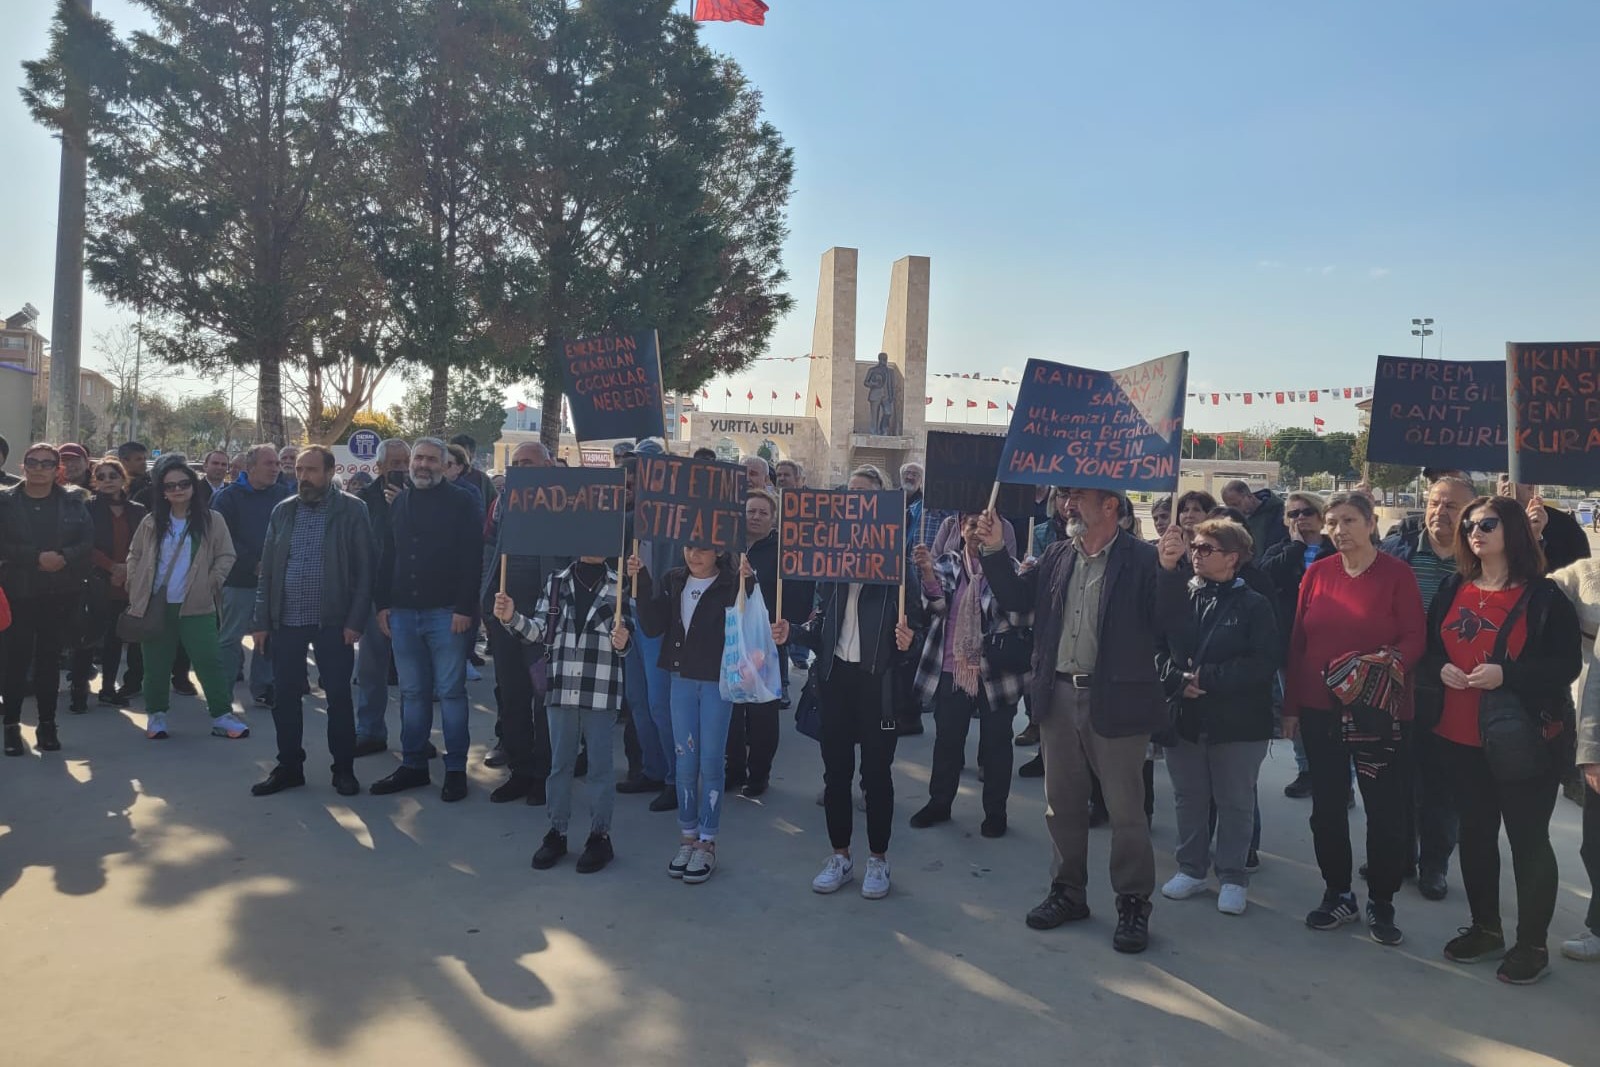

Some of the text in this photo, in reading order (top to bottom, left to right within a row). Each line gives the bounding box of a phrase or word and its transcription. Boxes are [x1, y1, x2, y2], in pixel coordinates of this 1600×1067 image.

[1382, 362, 1474, 382] DEPREM
[1389, 403, 1471, 423] RANT
[710, 419, 794, 435] YURTTA SULH
[1009, 449, 1065, 474] HALK
[636, 456, 746, 505] NOT ETME
[508, 484, 625, 513] AFAD=AFET
[783, 491, 878, 520] DEPREM
